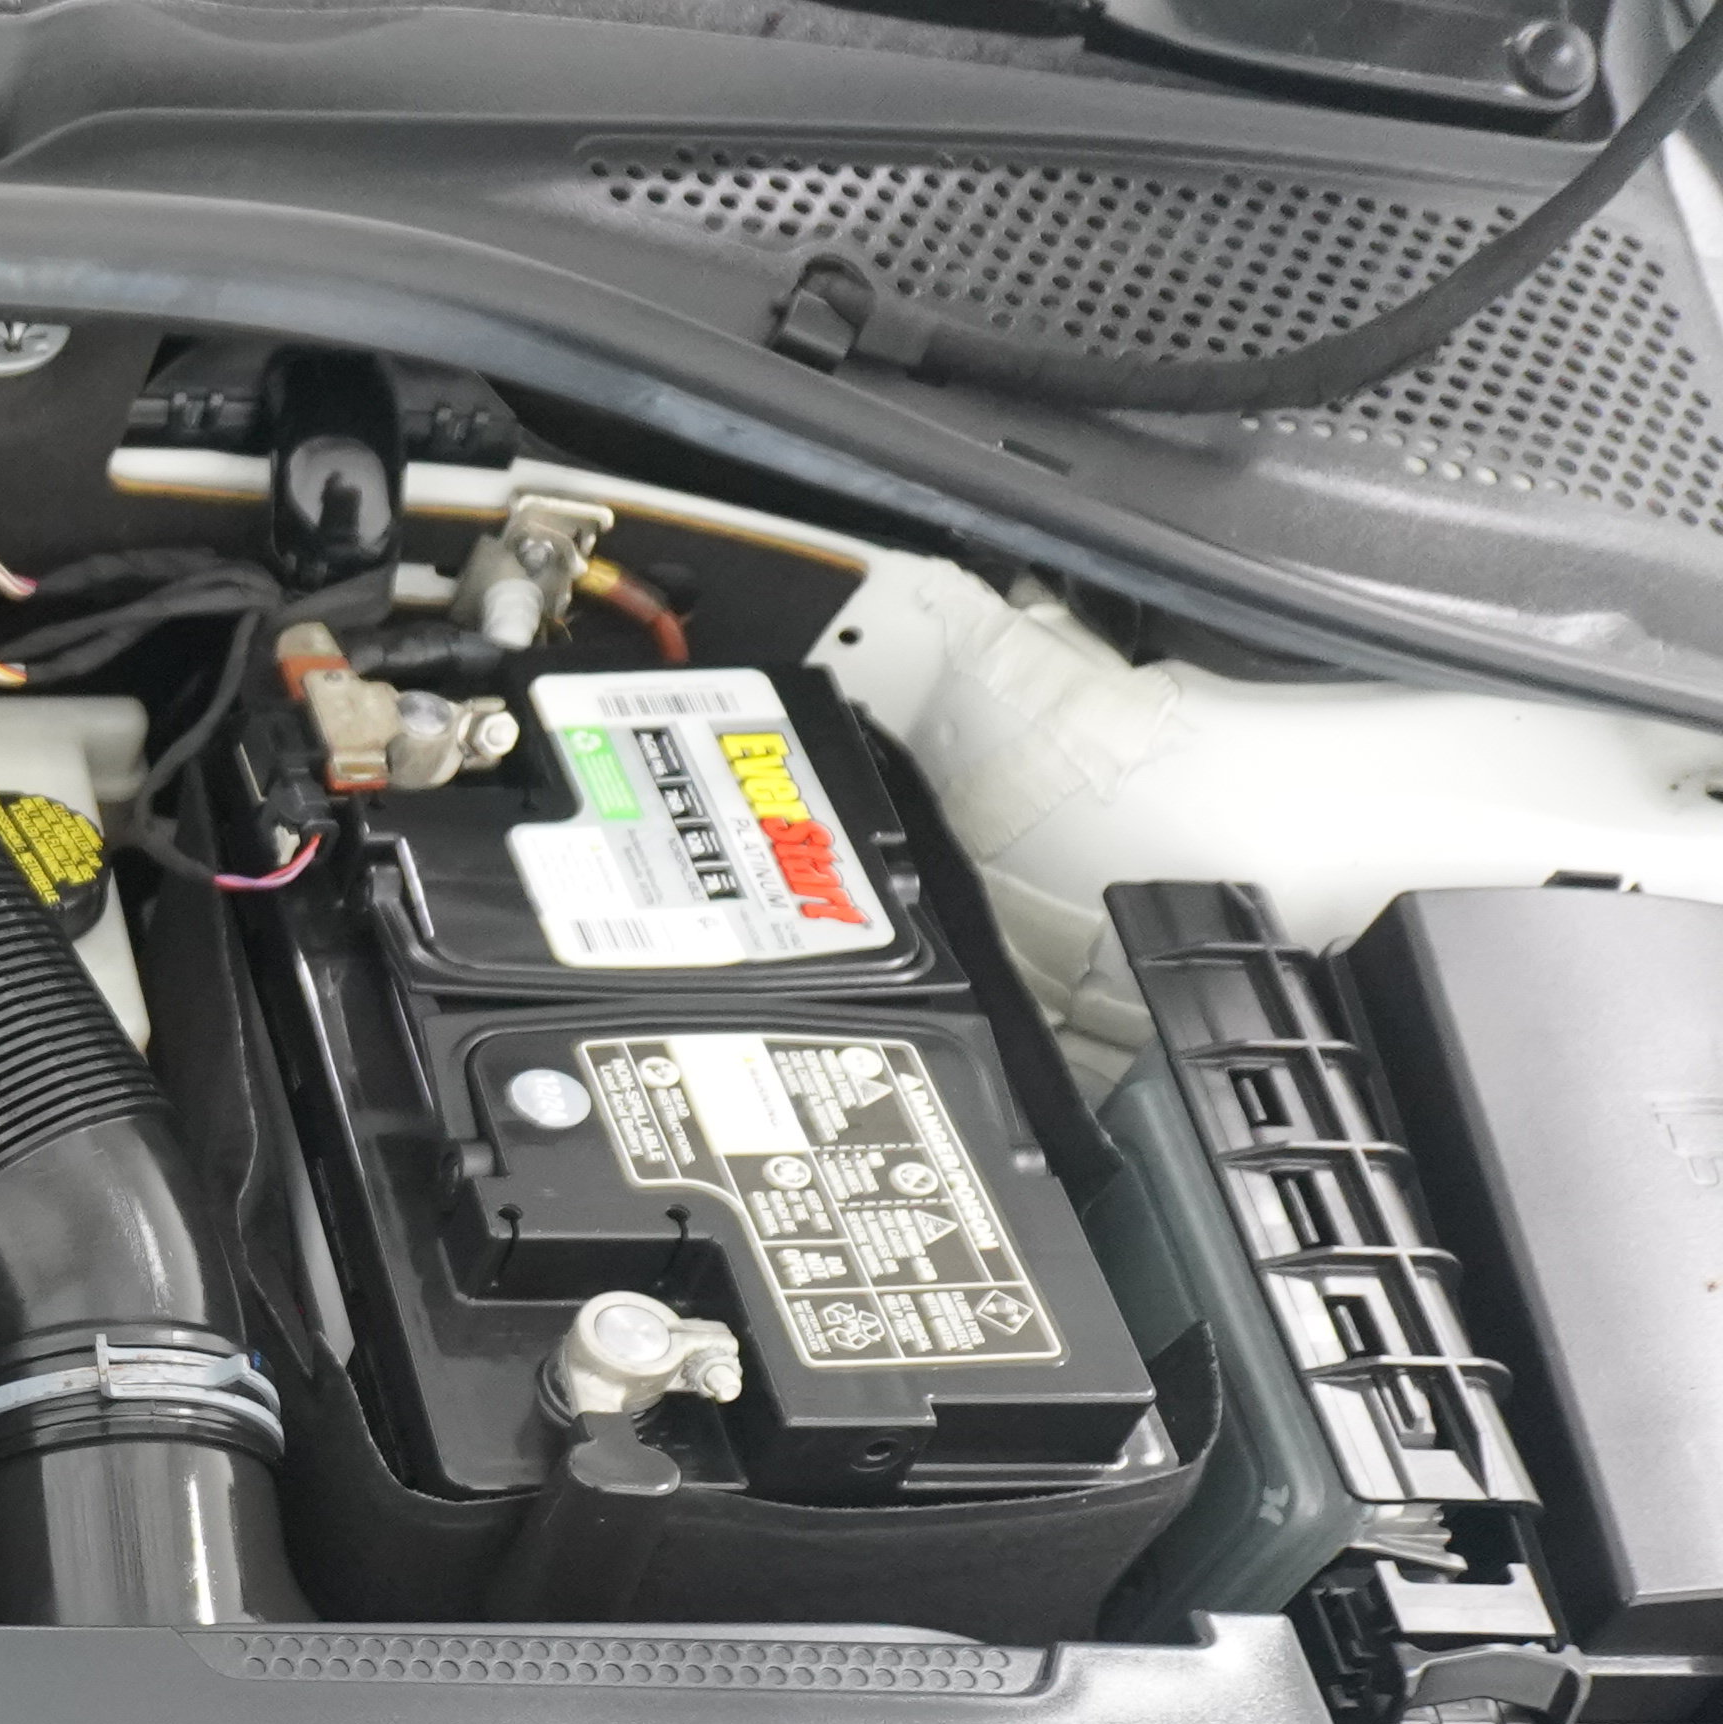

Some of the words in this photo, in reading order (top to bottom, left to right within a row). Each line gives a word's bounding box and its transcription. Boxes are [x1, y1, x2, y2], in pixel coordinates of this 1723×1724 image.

[636, 732, 663, 759] AGM
[681, 830, 707, 855] 120
[716, 730, 872, 927] EverStart
[728, 816, 789, 910] PLATINUM
[608, 1058, 672, 1161] NON-SPILLABLE
[908, 1089, 998, 1250] DANGER/POISON
